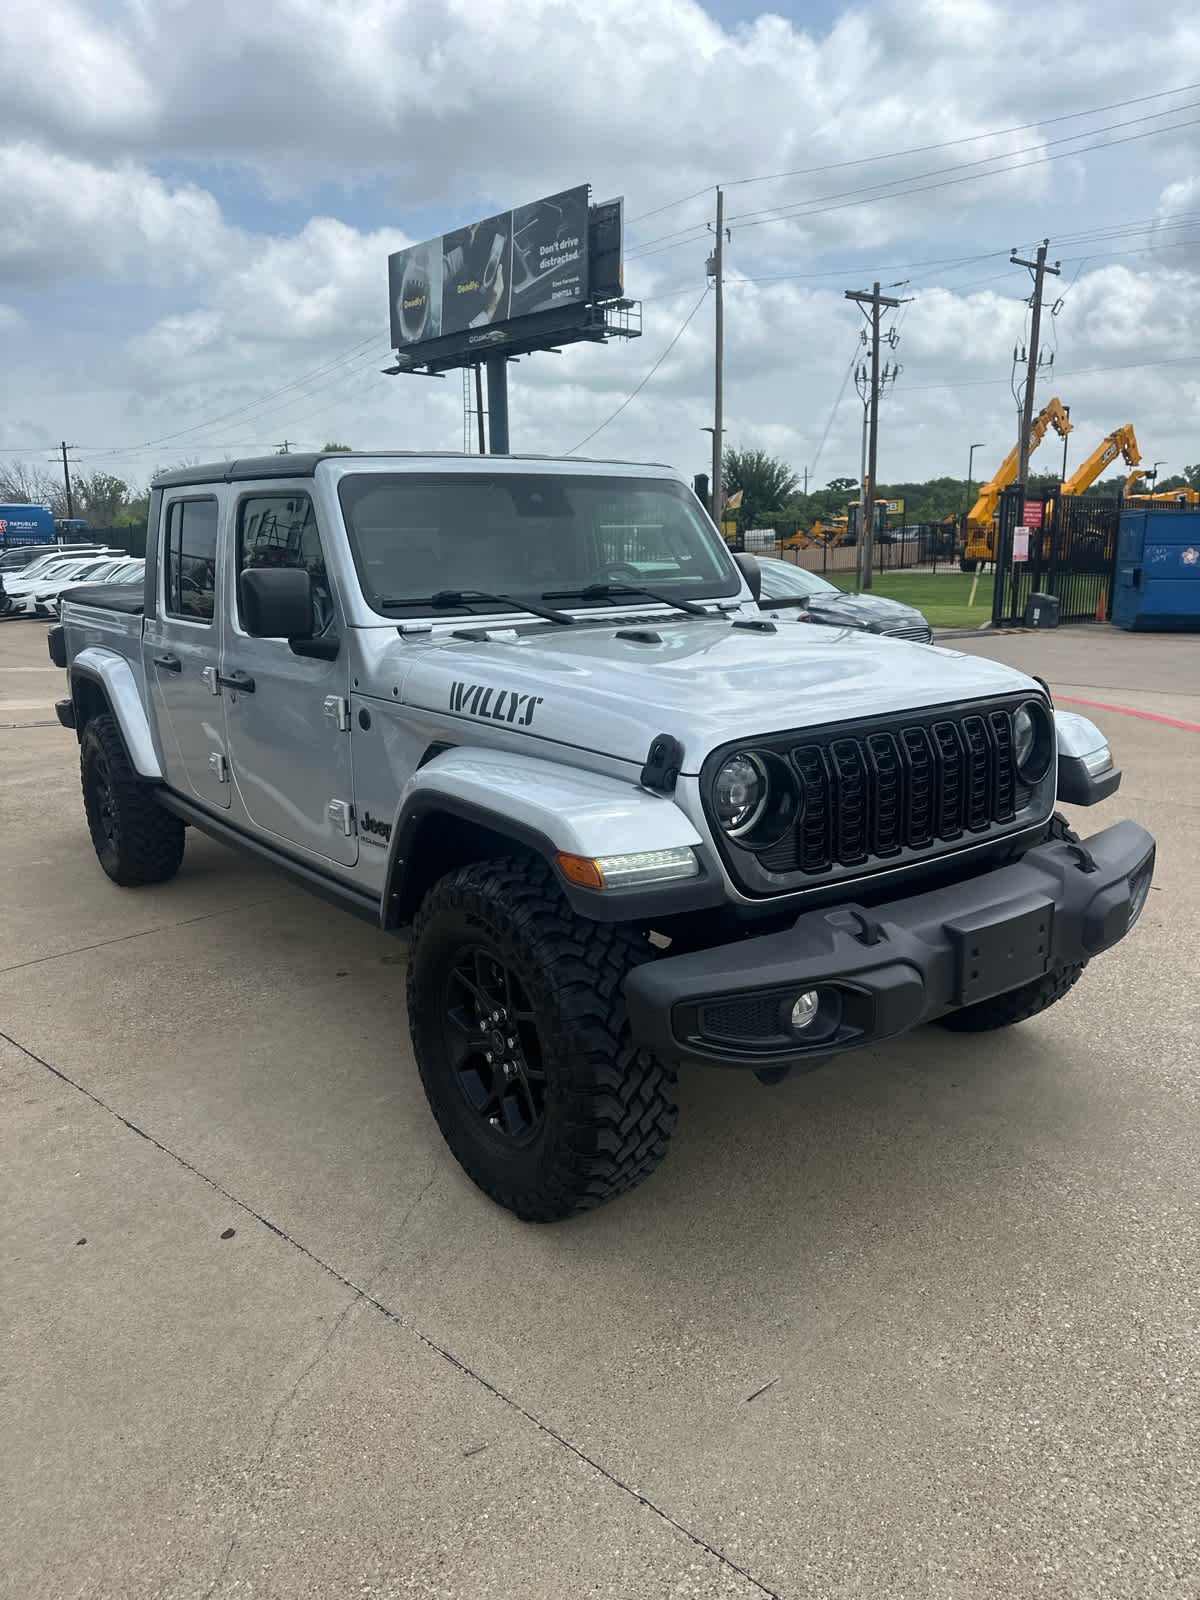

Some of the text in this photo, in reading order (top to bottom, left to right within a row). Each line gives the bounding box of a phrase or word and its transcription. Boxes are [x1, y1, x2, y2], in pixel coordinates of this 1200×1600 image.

[540, 237, 579, 255] Don't drive
[450, 681, 544, 726] WILLYS
[360, 811, 392, 842] Jeep
